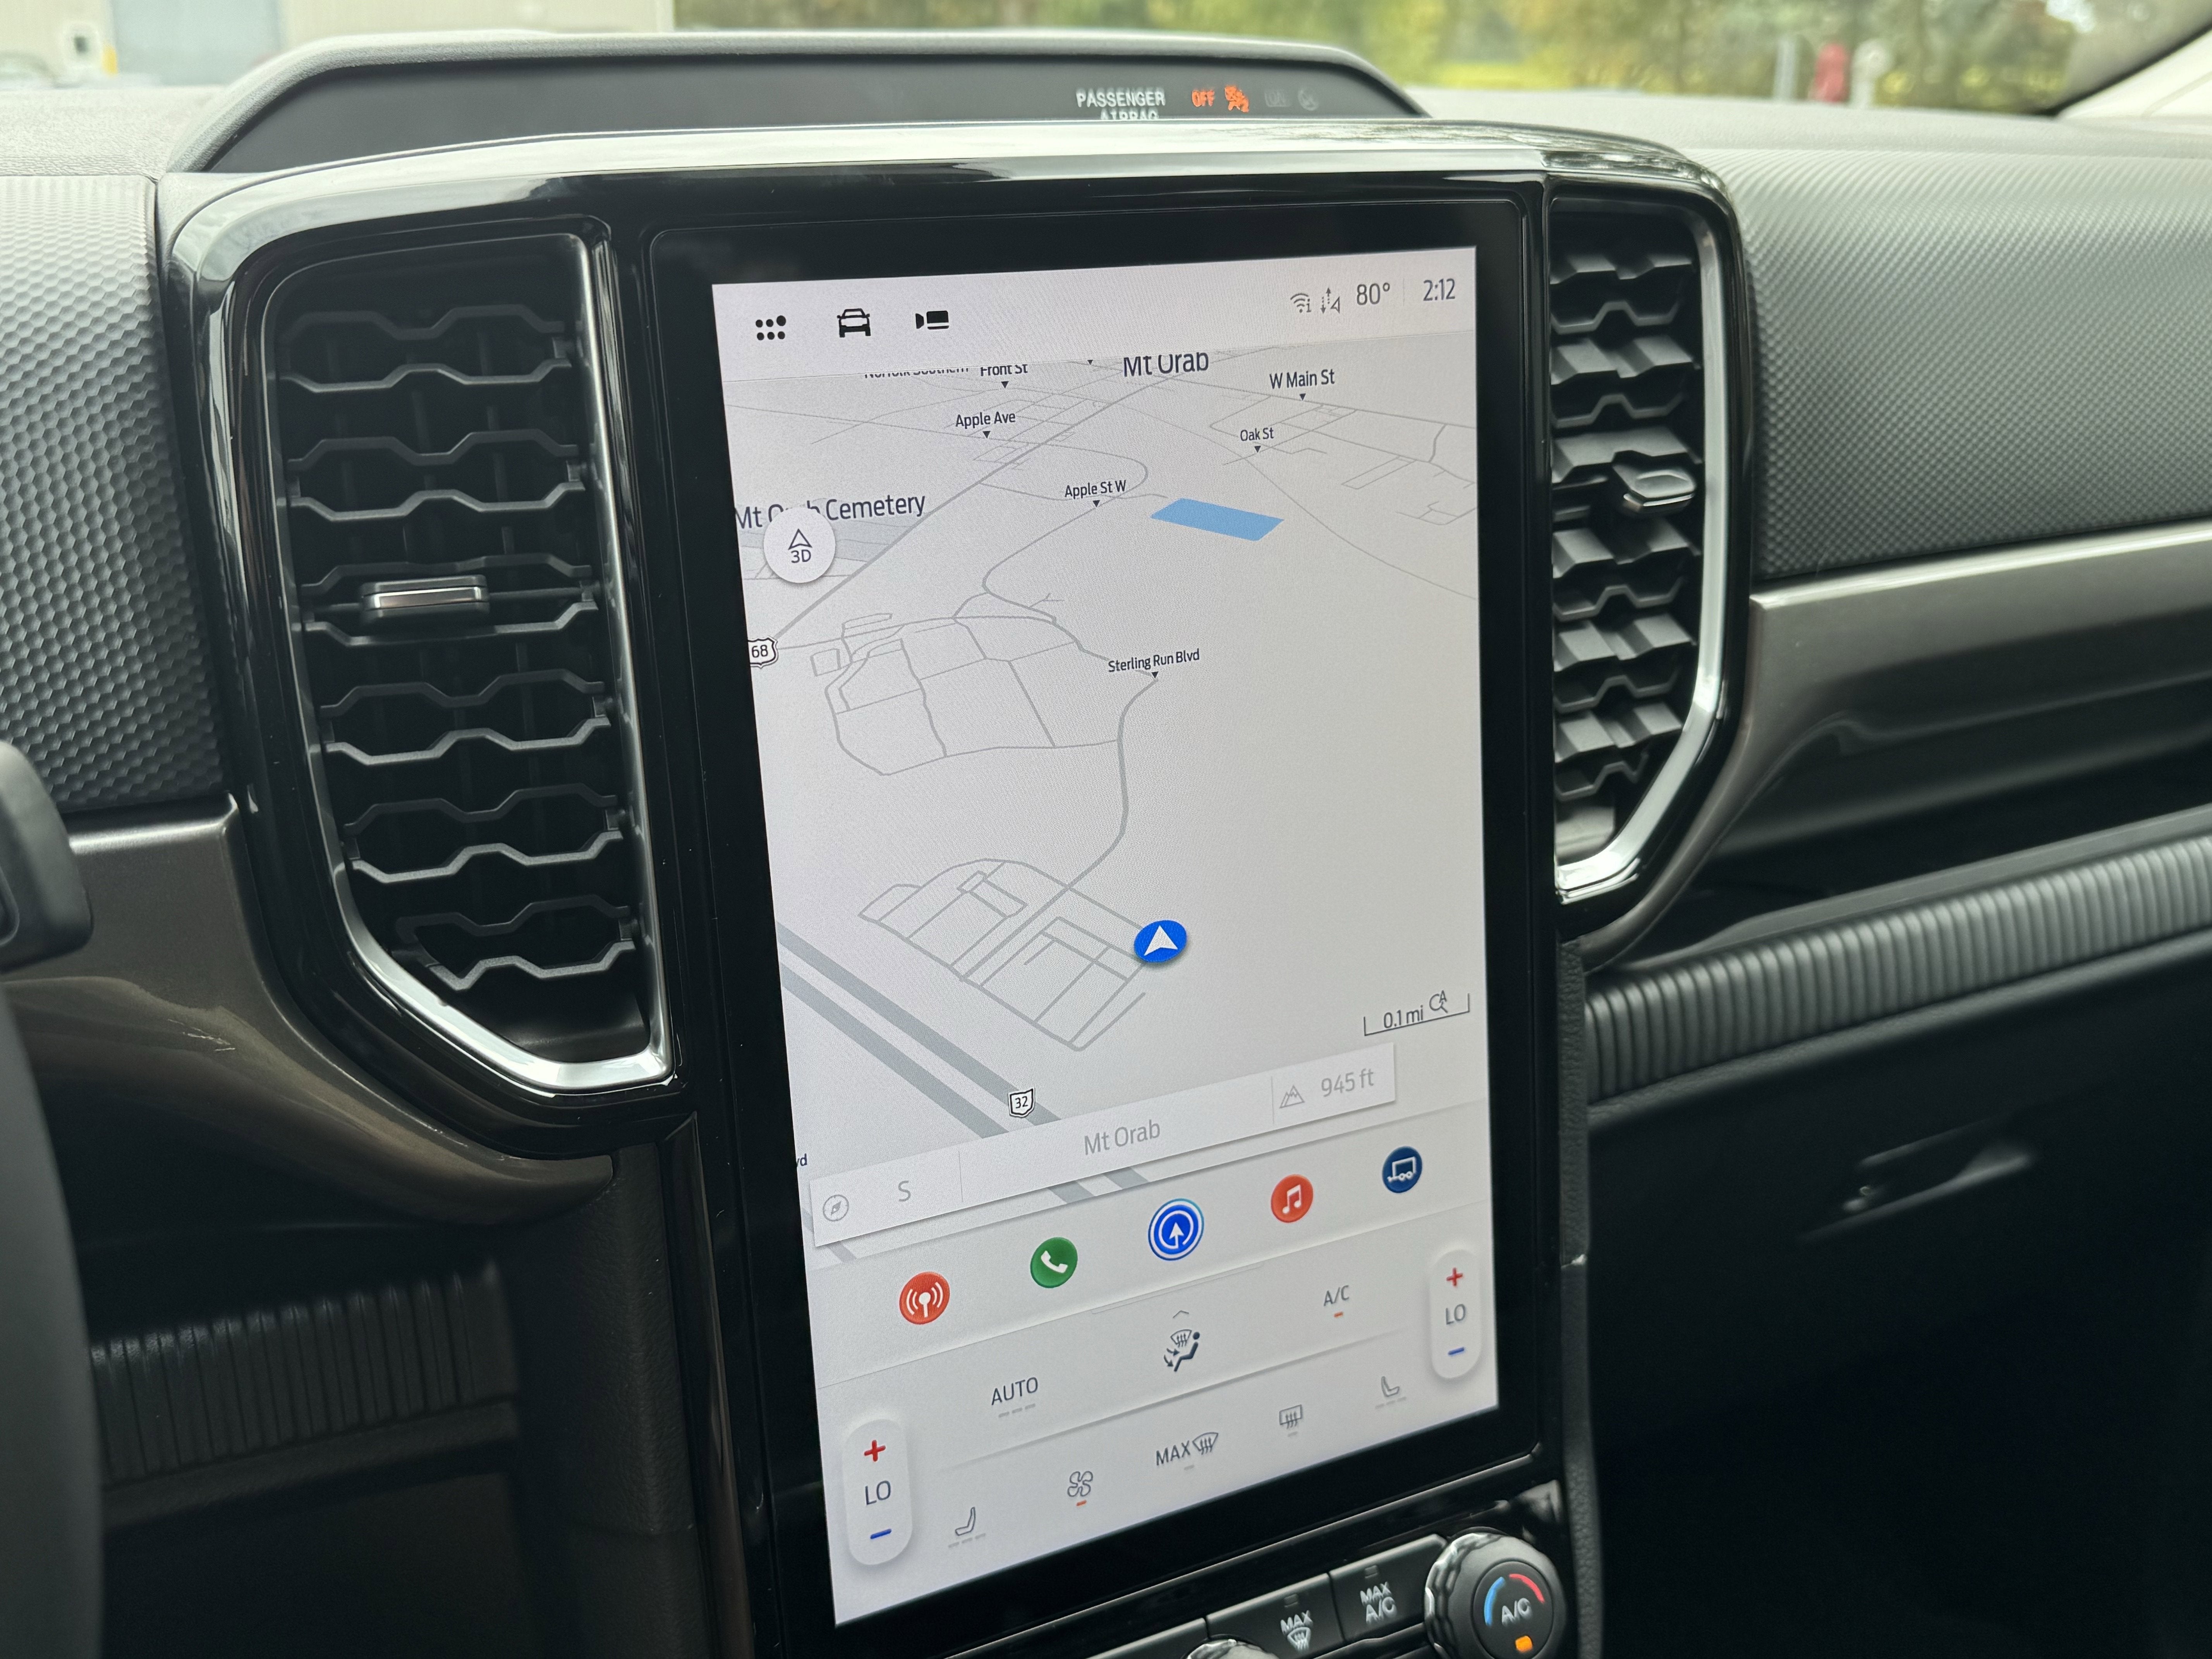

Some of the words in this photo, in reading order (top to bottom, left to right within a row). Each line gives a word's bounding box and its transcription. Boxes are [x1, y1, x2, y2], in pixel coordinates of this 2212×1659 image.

[1076, 90, 1166, 107] PASSENGER
[1192, 89, 1214, 107] OFF
[1356, 282, 1391, 306] 80°
[1423, 278, 1456, 302] 2:12
[980, 364, 1013, 376] Front
[1015, 364, 1029, 374] St
[1123, 356, 1152, 377] Mt
[1158, 352, 1209, 374] Orab
[1269, 372, 1283, 390] W
[1286, 370, 1317, 388] Main
[1321, 368, 1335, 385] St
[955, 411, 991, 429] Apple
[994, 411, 1016, 424] Ave
[1240, 428, 1261, 441] Oak
[1262, 427, 1274, 440] St
[1064, 482, 1097, 498] Apple
[1100, 481, 1112, 495] St
[1115, 480, 1127, 492] W
[735, 506, 763, 529] Mt
[826, 495, 926, 520] Cemetery
[791, 549, 812, 563] 3D
[751, 644, 769, 658] 68
[1108, 657, 1151, 672] Sterling
[1153, 654, 1174, 666] Run
[1176, 648, 1200, 663] Blvd
[1383, 1009, 1402, 1029] 0.1
[1406, 1005, 1424, 1024] mi
[1321, 1072, 1355, 1097] 945
[1360, 1068, 1374, 1088] ft
[1015, 1096, 1028, 1109] 32
[1084, 1132, 1110, 1155] Mt
[1115, 1119, 1160, 1147] Orab
[898, 1180, 911, 1202] S
[1323, 1285, 1350, 1306] A/C
[1445, 1304, 1466, 1325] LO
[991, 1377, 1039, 1405] AUTO
[1156, 1441, 1192, 1466] MAX
[865, 1480, 892, 1506] LO
[1360, 1581, 1392, 1606] MAX
[1280, 1610, 1313, 1634] MAX
[1366, 1596, 1398, 1624] A/C
[1501, 1597, 1533, 1625] A/C
